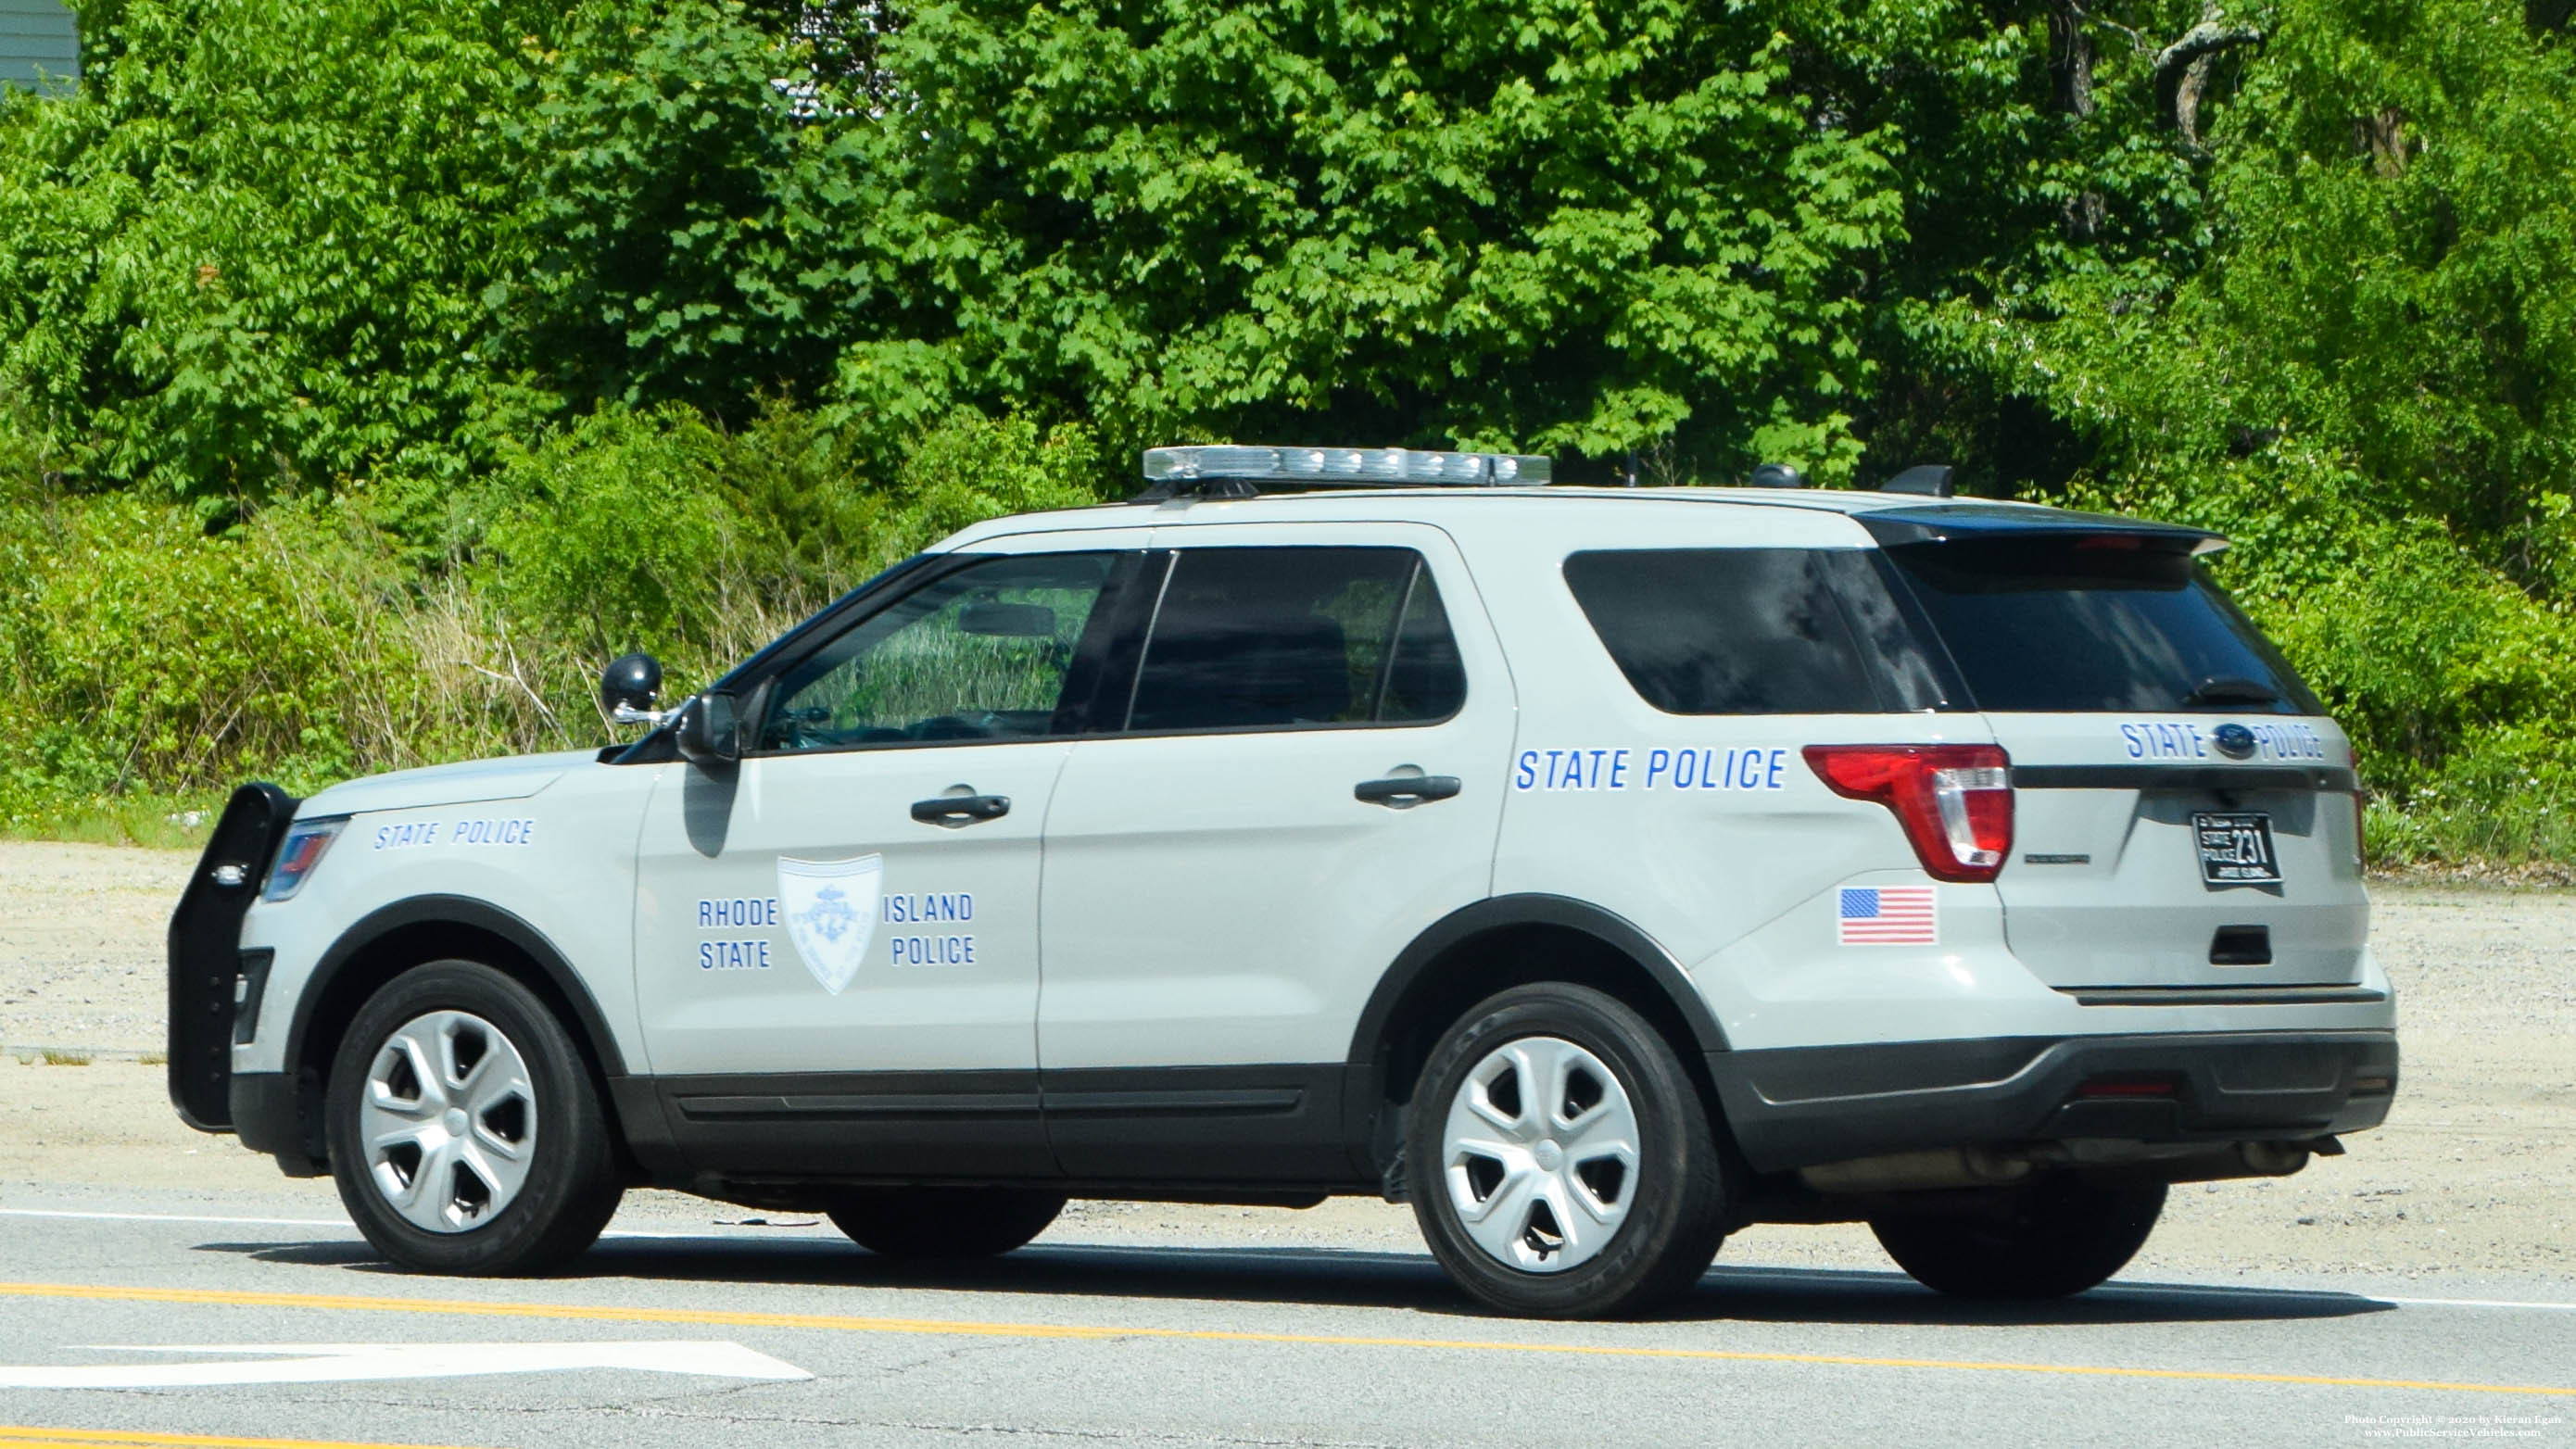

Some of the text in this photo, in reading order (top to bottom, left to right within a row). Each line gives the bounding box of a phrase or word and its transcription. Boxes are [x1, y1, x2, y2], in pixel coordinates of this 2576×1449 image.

[2120, 724, 2207, 758] STATE
[2253, 724, 2324, 759] POLICE
[1516, 748, 1787, 789] STATE POLICE
[373, 819, 534, 850] STATE POLICE
[2201, 830, 2231, 846] STATE
[2231, 829, 2268, 864] 231
[698, 893, 973, 927] RHODE ISLAND
[700, 940, 770, 969] STATE
[890, 936, 976, 964] POLICE
